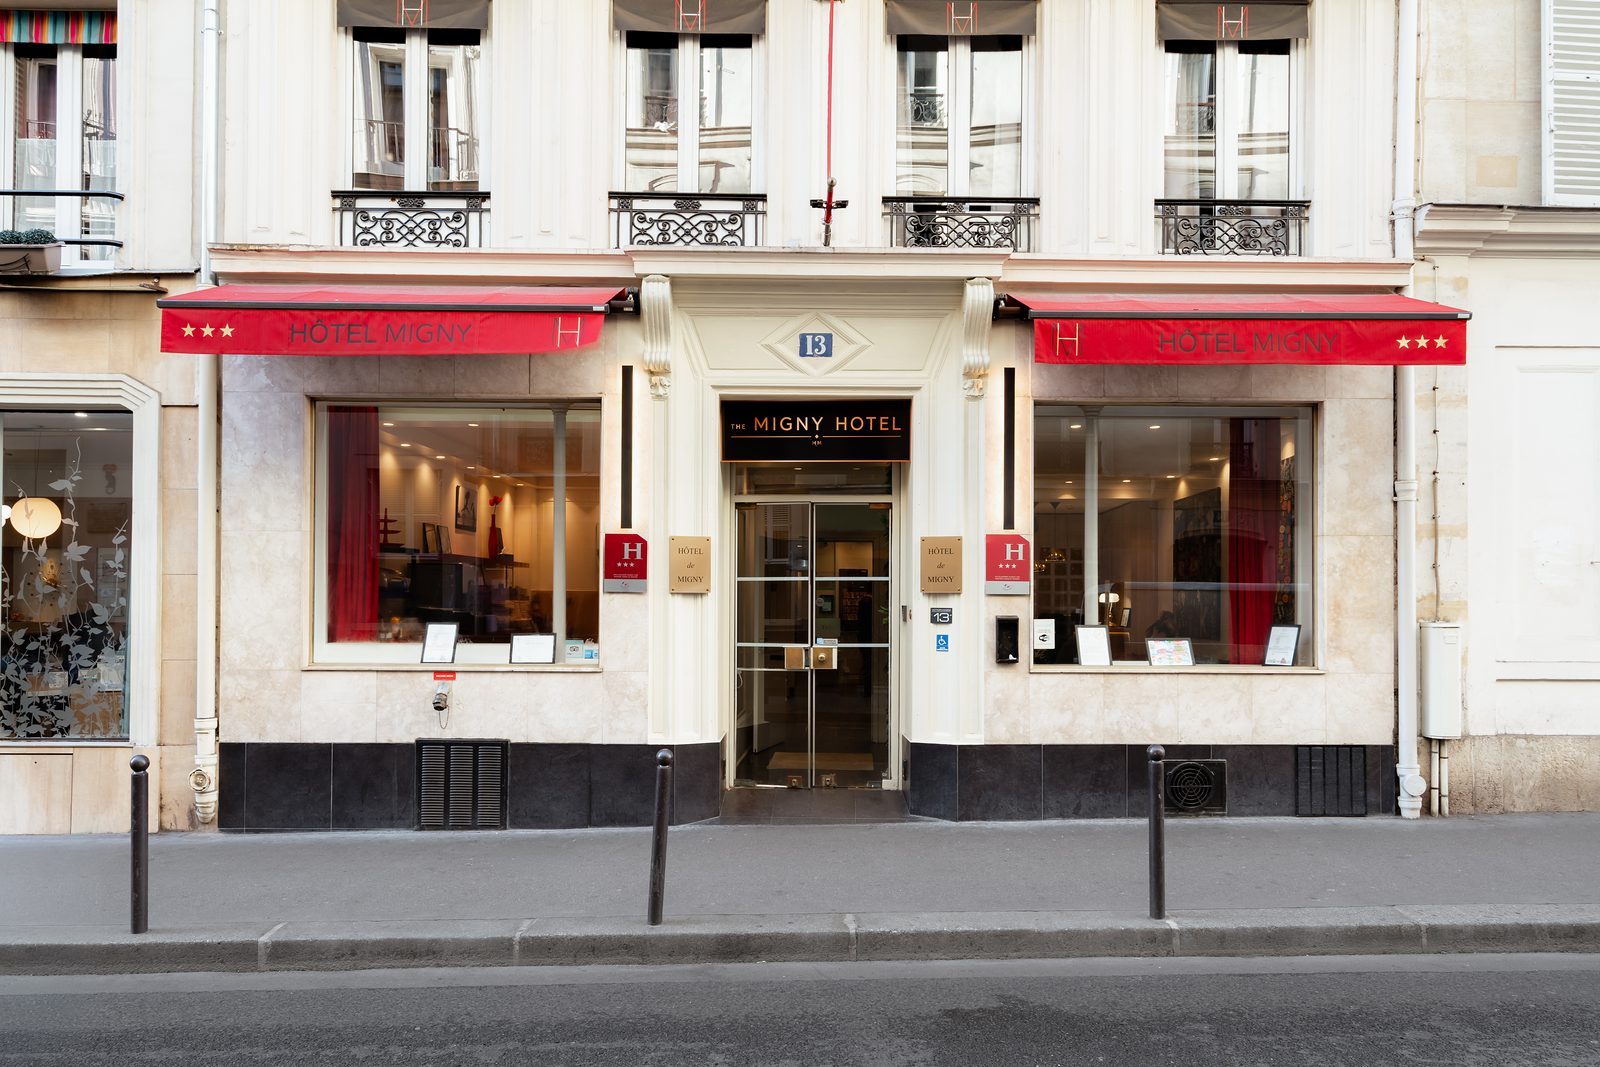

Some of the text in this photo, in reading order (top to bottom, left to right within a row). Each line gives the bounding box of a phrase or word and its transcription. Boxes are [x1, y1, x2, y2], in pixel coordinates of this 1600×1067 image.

[291, 319, 472, 344] HÔTEL MIGNY
[806, 335, 826, 355] 13
[1160, 329, 1339, 353] HÔTEL MIGNY
[754, 416, 824, 431] MIGNY
[835, 416, 902, 431] HOTEL
[622, 542, 643, 560] H
[678, 546, 704, 555] HÔTEL
[1005, 543, 1025, 561] H
[686, 561, 696, 569] de
[936, 561, 946, 569] de
[677, 575, 704, 583] MIGNY
[927, 575, 954, 583] MIGNY
[933, 612, 950, 623] 13
